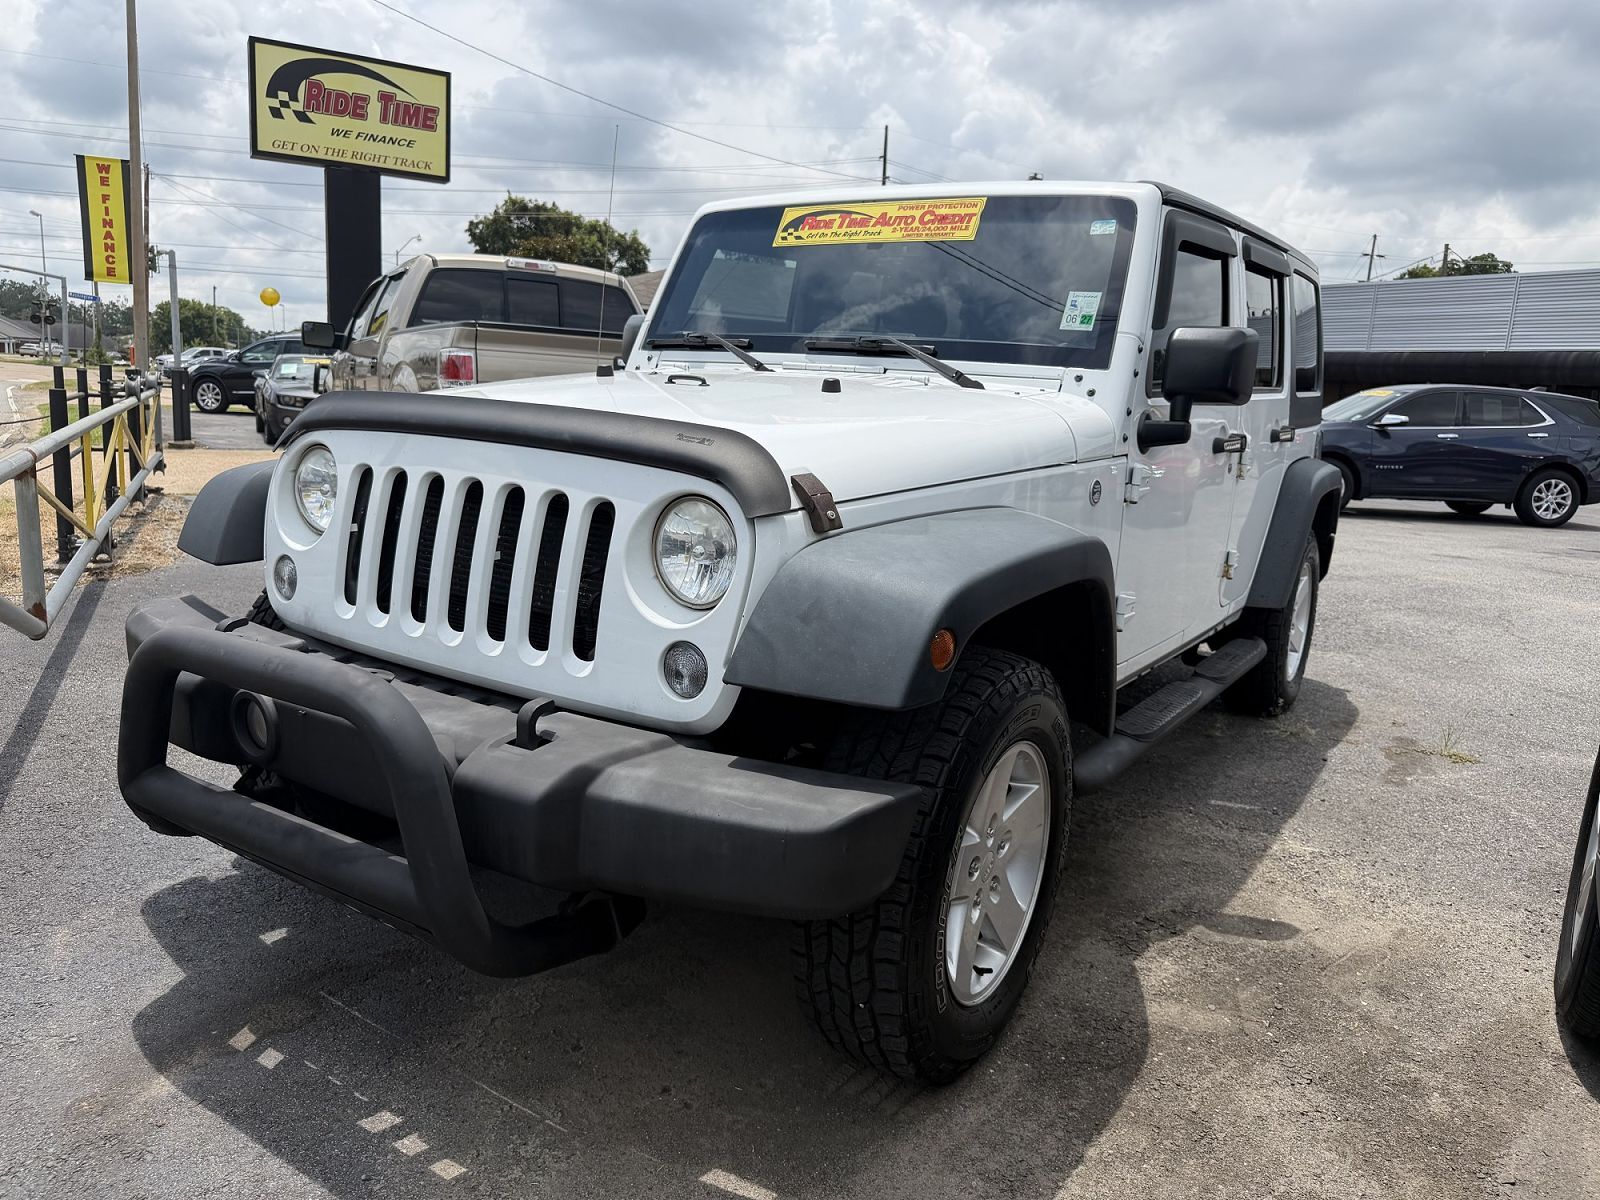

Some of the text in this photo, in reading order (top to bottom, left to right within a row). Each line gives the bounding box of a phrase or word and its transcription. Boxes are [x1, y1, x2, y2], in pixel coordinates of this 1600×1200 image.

[303, 78, 440, 132] RIDE TIME
[330, 127, 417, 149] WE FINANCE
[271, 139, 433, 171] GET ON THE RIGHT TRACK
[927, 202, 979, 211] PROTECTION
[95, 163, 117, 277] WE FINANCE
[801, 210, 977, 231] RIDE TIME AUTO CREDIT
[949, 224, 970, 232] MILE
[843, 230, 862, 238] Right
[863, 229, 883, 237] Track
[1066, 314, 1093, 325] 06 27
